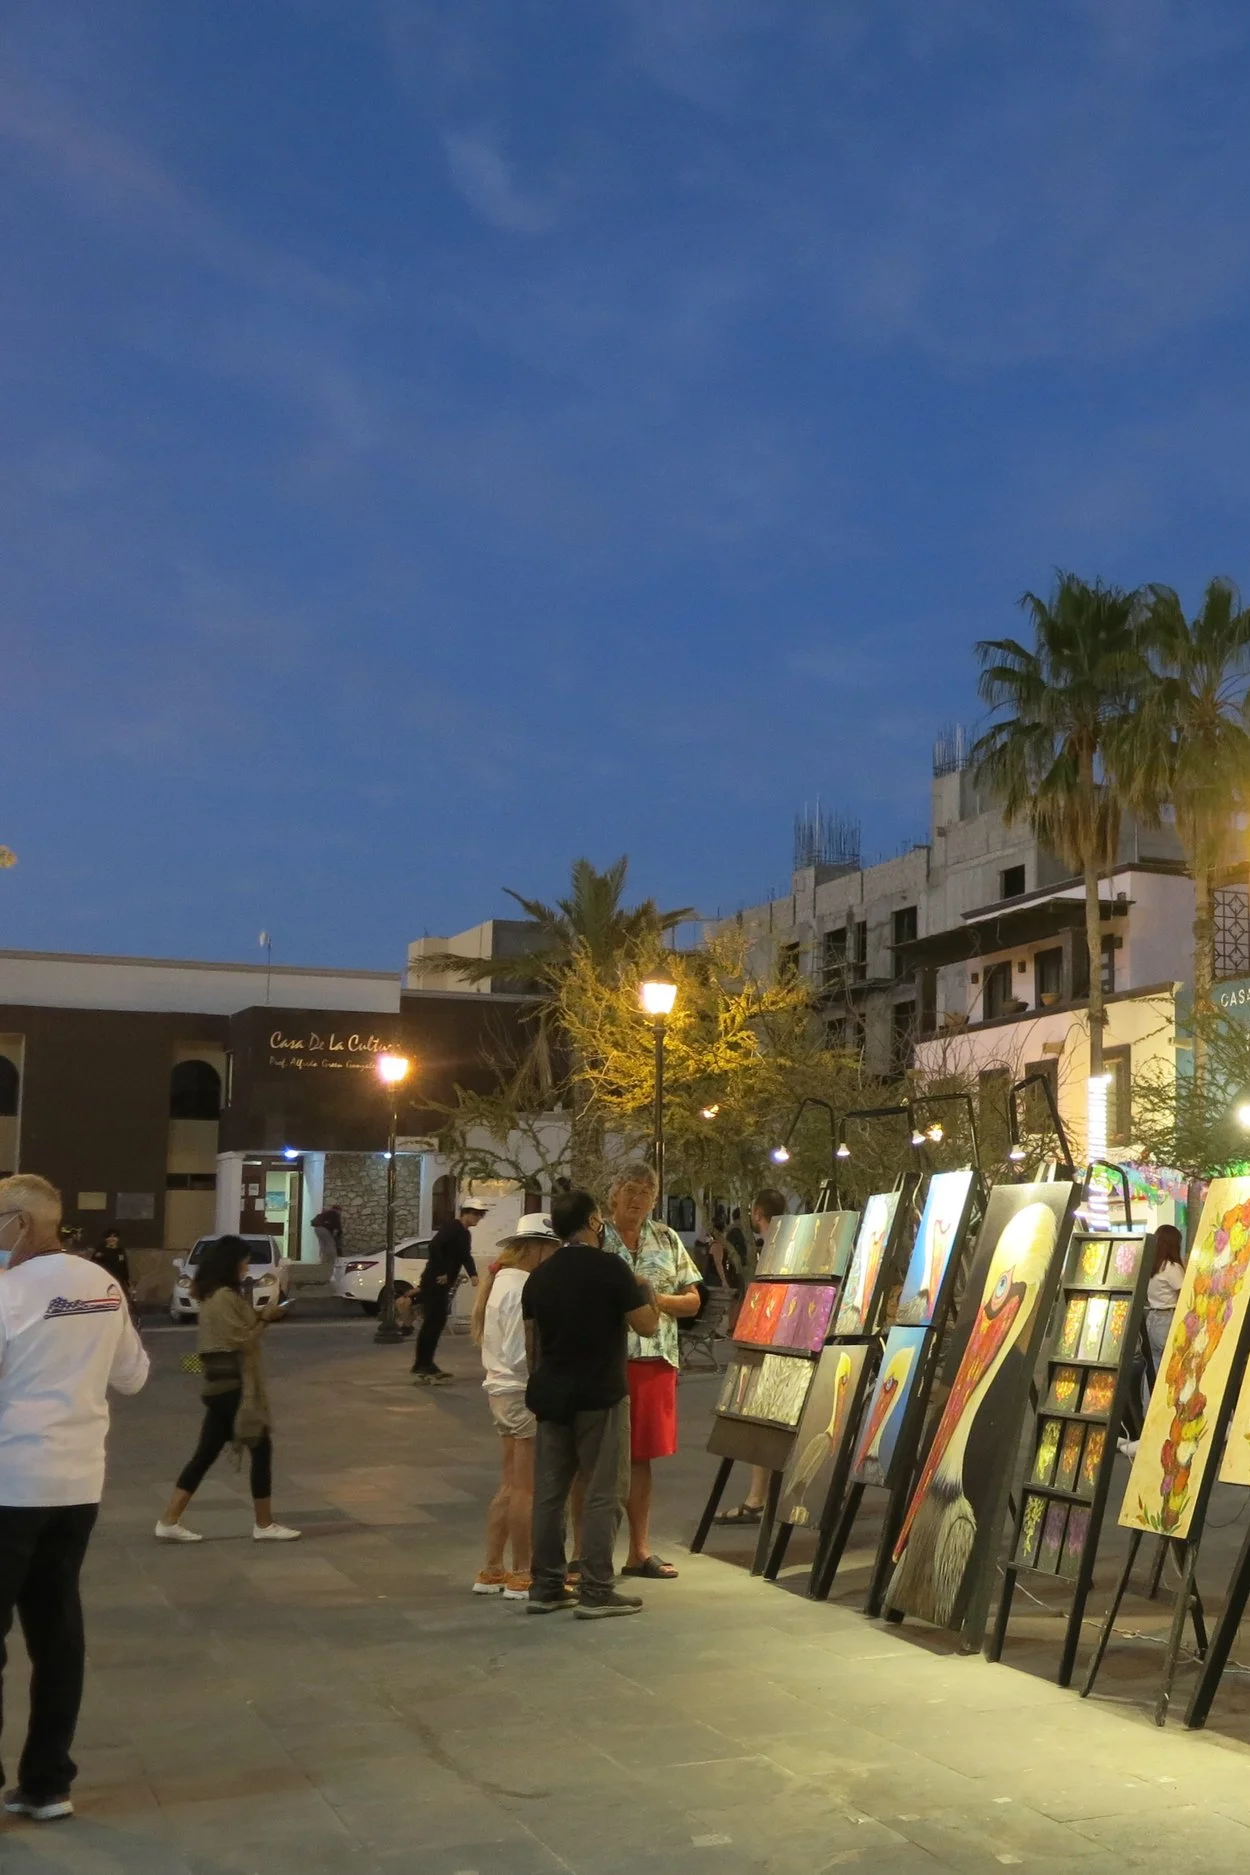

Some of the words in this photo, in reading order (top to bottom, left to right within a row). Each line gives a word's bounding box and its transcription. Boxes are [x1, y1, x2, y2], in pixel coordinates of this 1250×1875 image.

[270, 1031, 303, 1049] Casa
[309, 1032, 325, 1051] De
[329, 1033, 344, 1051] La
